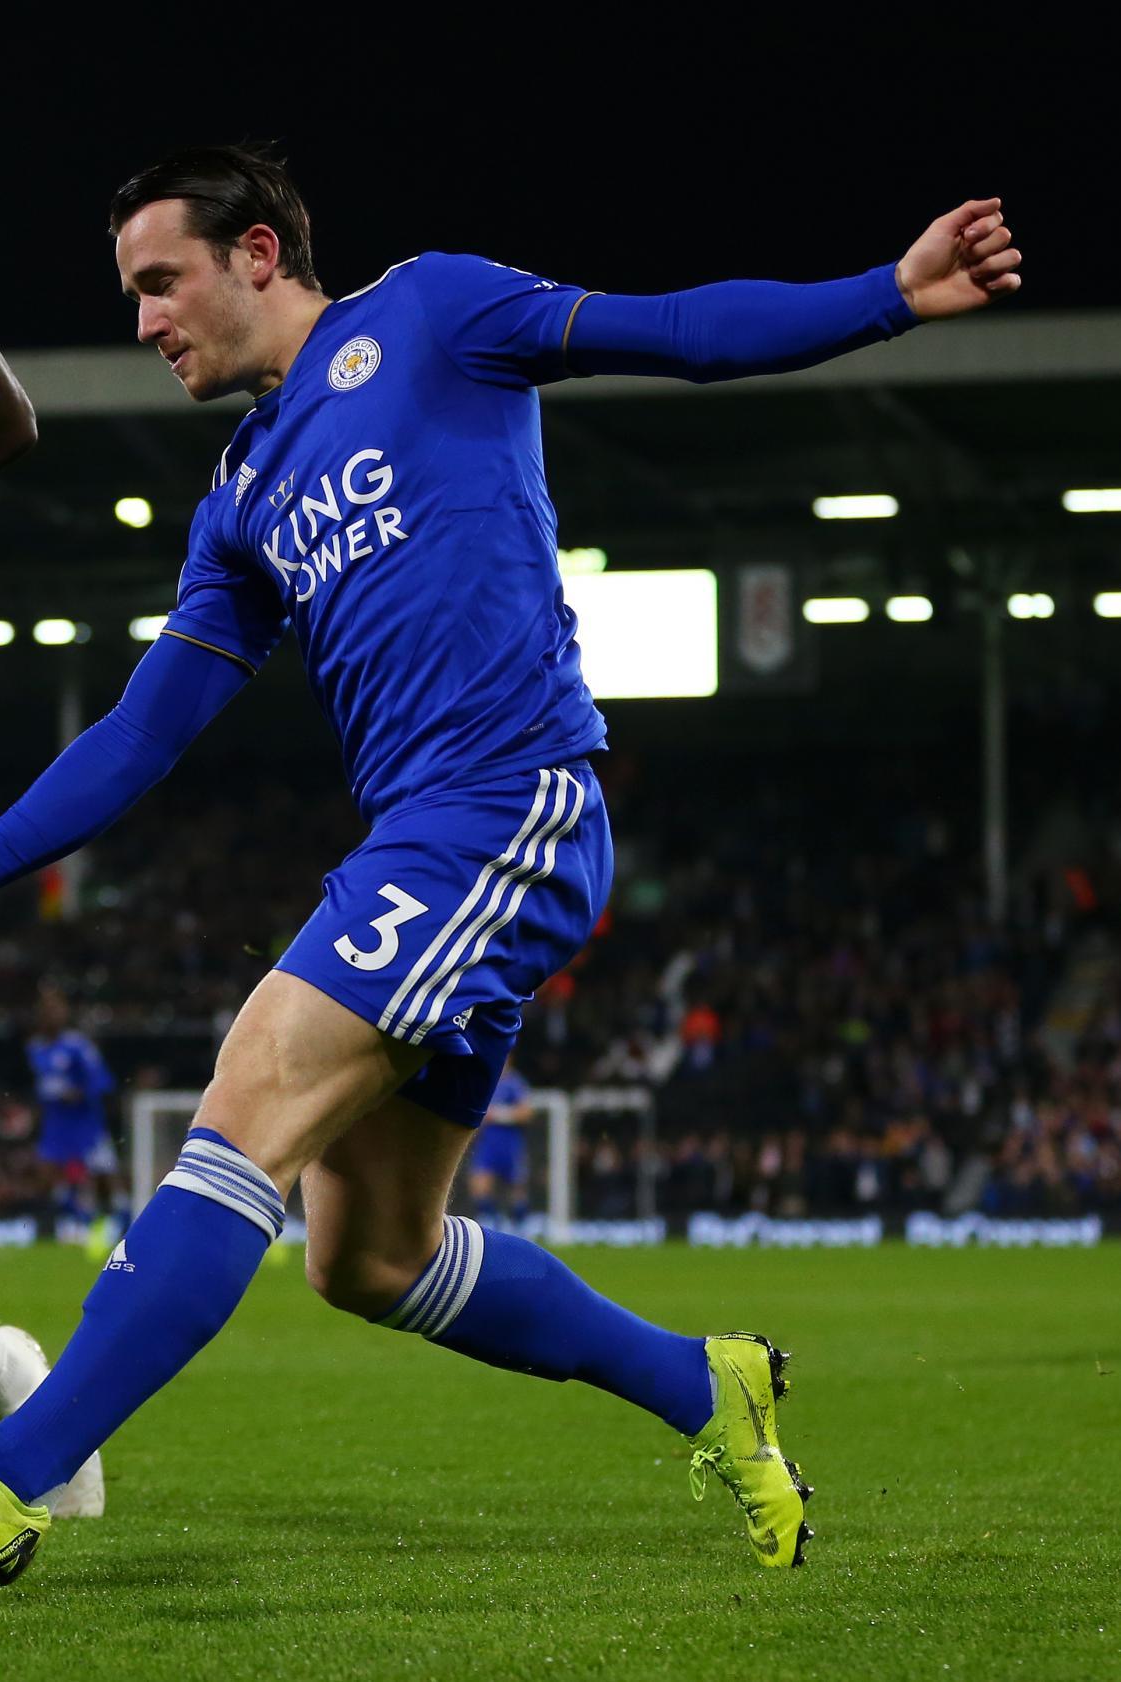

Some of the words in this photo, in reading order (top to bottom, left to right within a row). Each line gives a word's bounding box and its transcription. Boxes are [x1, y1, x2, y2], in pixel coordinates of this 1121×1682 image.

[332, 342, 361, 375] LEICESTER
[361, 342, 375, 352] CITY
[334, 373, 367, 386] FOOTBALL
[365, 354, 376, 374] CLUB
[263, 449, 393, 587] KING
[295, 507, 409, 602] OWER
[333, 883, 429, 971] 3
